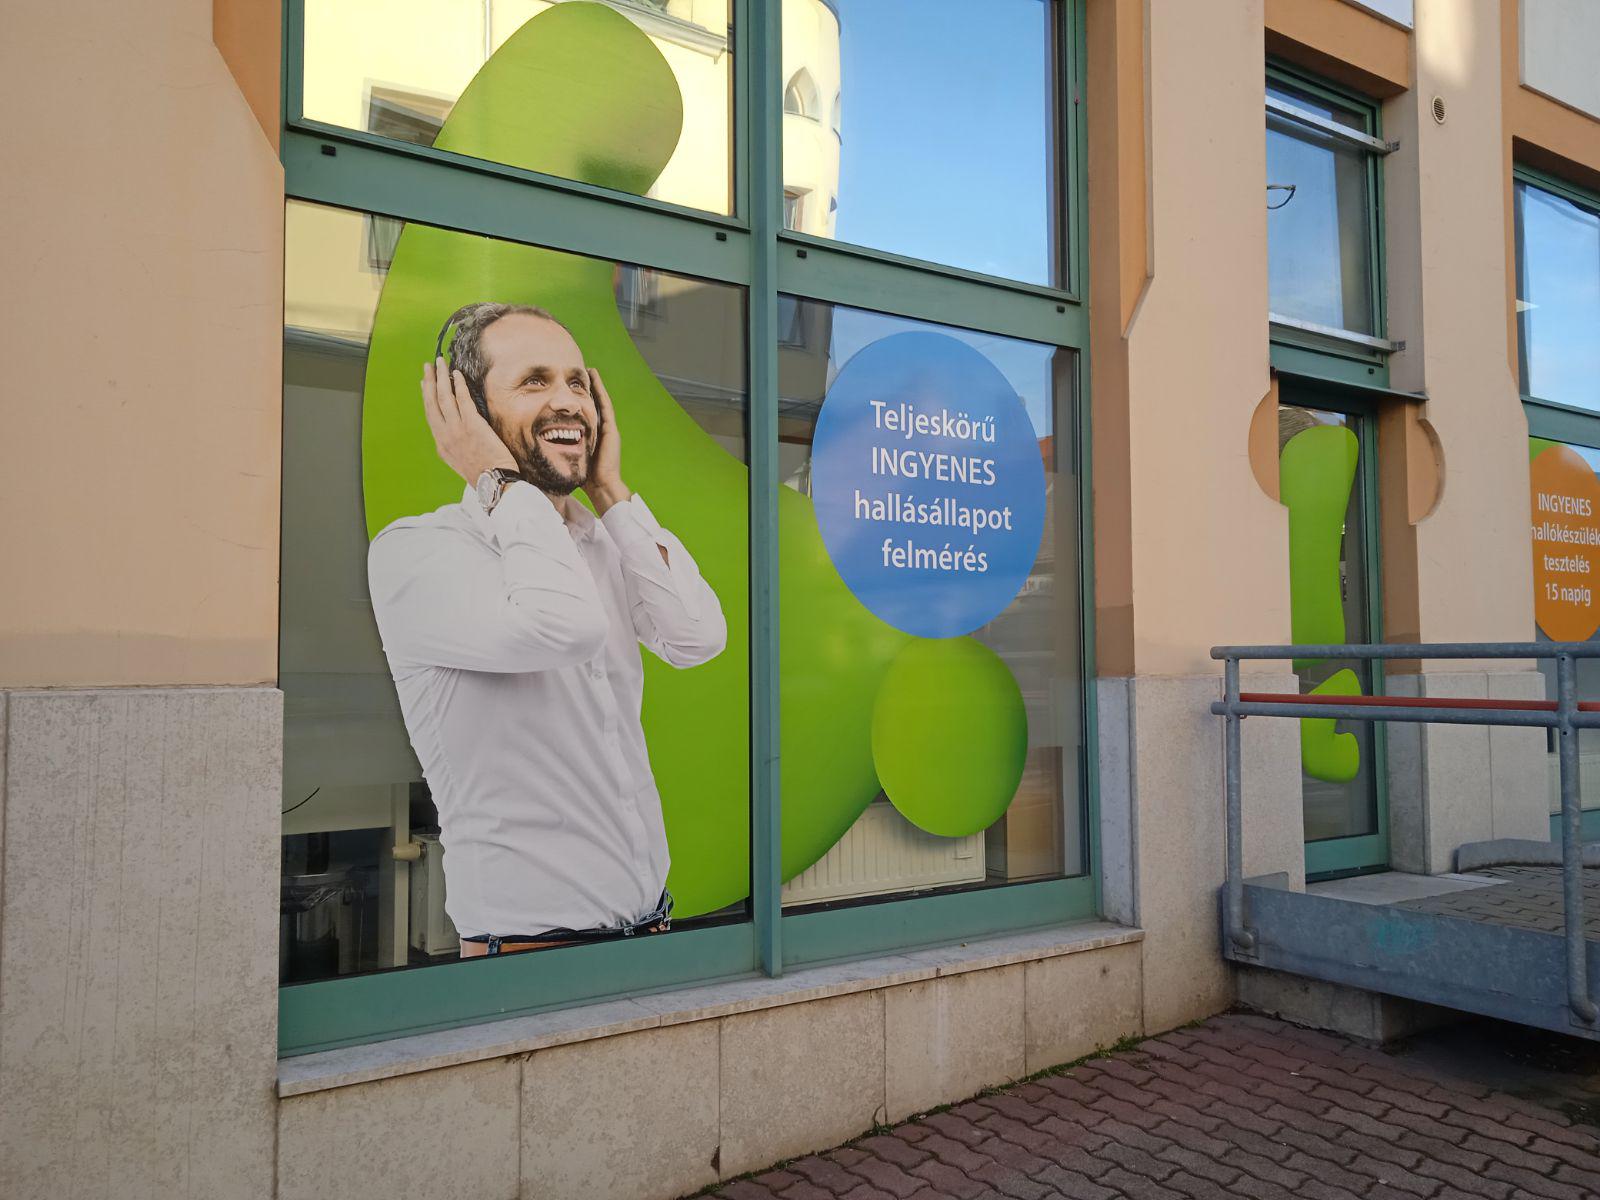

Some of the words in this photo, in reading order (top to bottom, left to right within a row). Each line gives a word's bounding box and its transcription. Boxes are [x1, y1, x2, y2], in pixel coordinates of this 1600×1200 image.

[870, 400, 995, 442] Teljeskörű
[871, 447, 996, 486] INGYENES
[854, 490, 1012, 535] hallásállapot
[1538, 493, 1592, 516] INGYENES
[882, 538, 988, 572] felmérés
[1544, 554, 1590, 573] tesztelés
[1545, 583, 1559, 600] 15
[1561, 585, 1591, 606] napig
